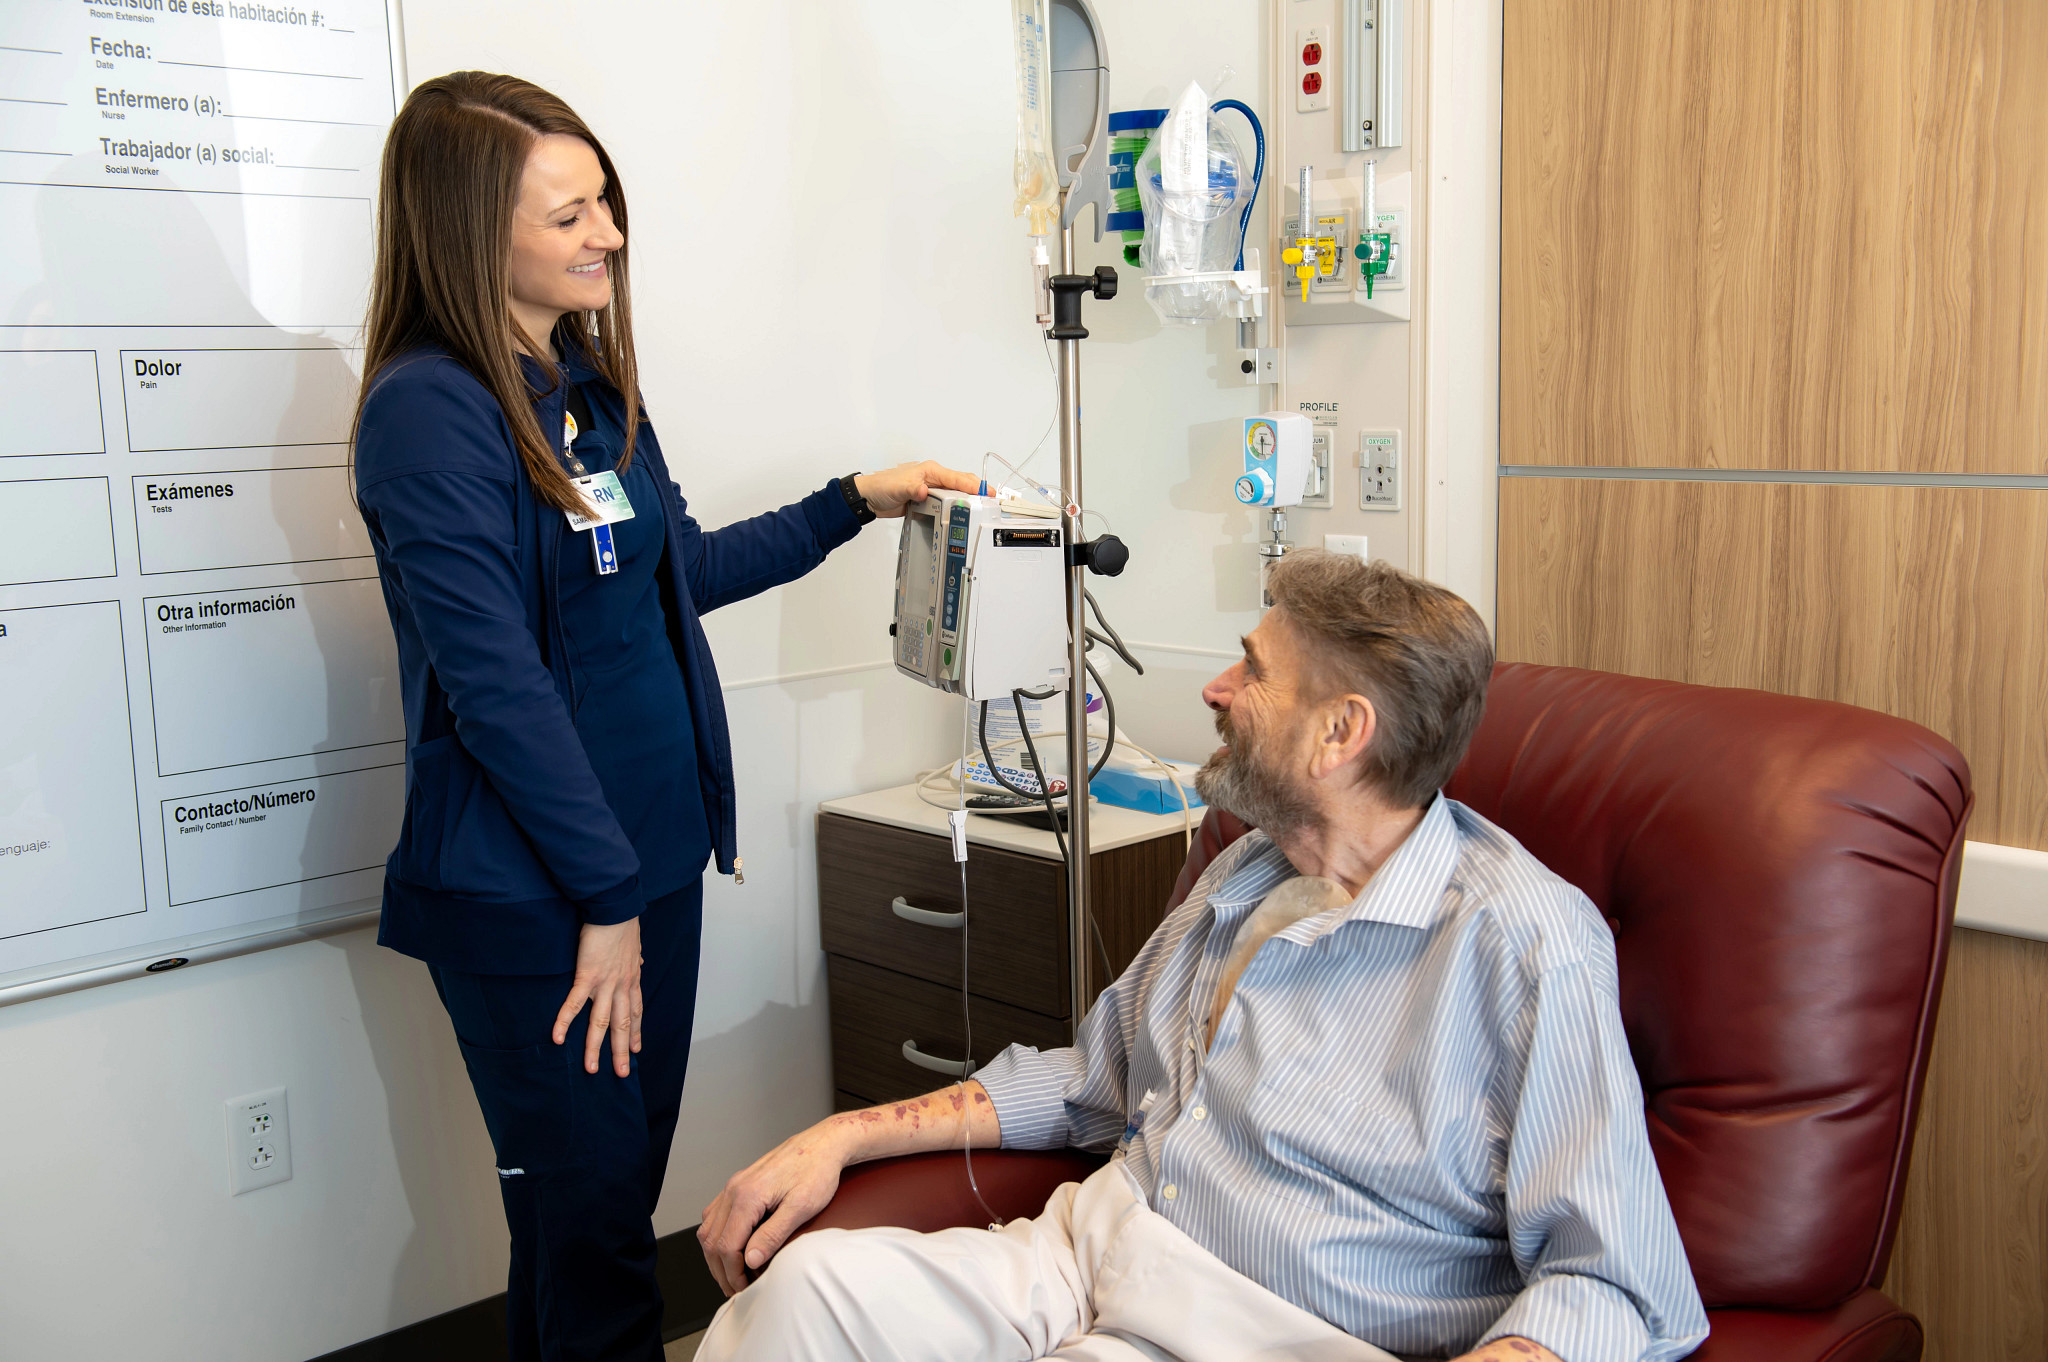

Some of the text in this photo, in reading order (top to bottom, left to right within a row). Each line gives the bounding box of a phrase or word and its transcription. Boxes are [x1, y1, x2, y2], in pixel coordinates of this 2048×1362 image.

[90, 9, 155, 23] Room Extension
[168, 0, 187, 13] de
[192, 0, 225, 17] esta
[229, 0, 307, 25] habitación
[311, 10, 325, 27] #:
[90, 36, 151, 59] Fecha:
[95, 60, 114, 69] Date
[95, 87, 222, 117] Enfermero (a):
[102, 110, 125, 120] Nurse
[99, 137, 275, 165] Trabajador (a) social:
[105, 164, 160, 176] Social Worker
[135, 359, 182, 376] Dolor
[140, 381, 157, 389] Pain
[1300, 402, 1338, 411] PROFILE
[146, 483, 234, 501] Exámenes
[592, 486, 616, 503] RN
[152, 505, 172, 513] Tests
[157, 593, 296, 622] Otra información
[162, 620, 227, 634] Other Information
[175, 789, 316, 823] Contacto/Número
[179, 824, 204, 835] Family
[206, 819, 233, 830] Contact
[239, 814, 267, 825] Number
